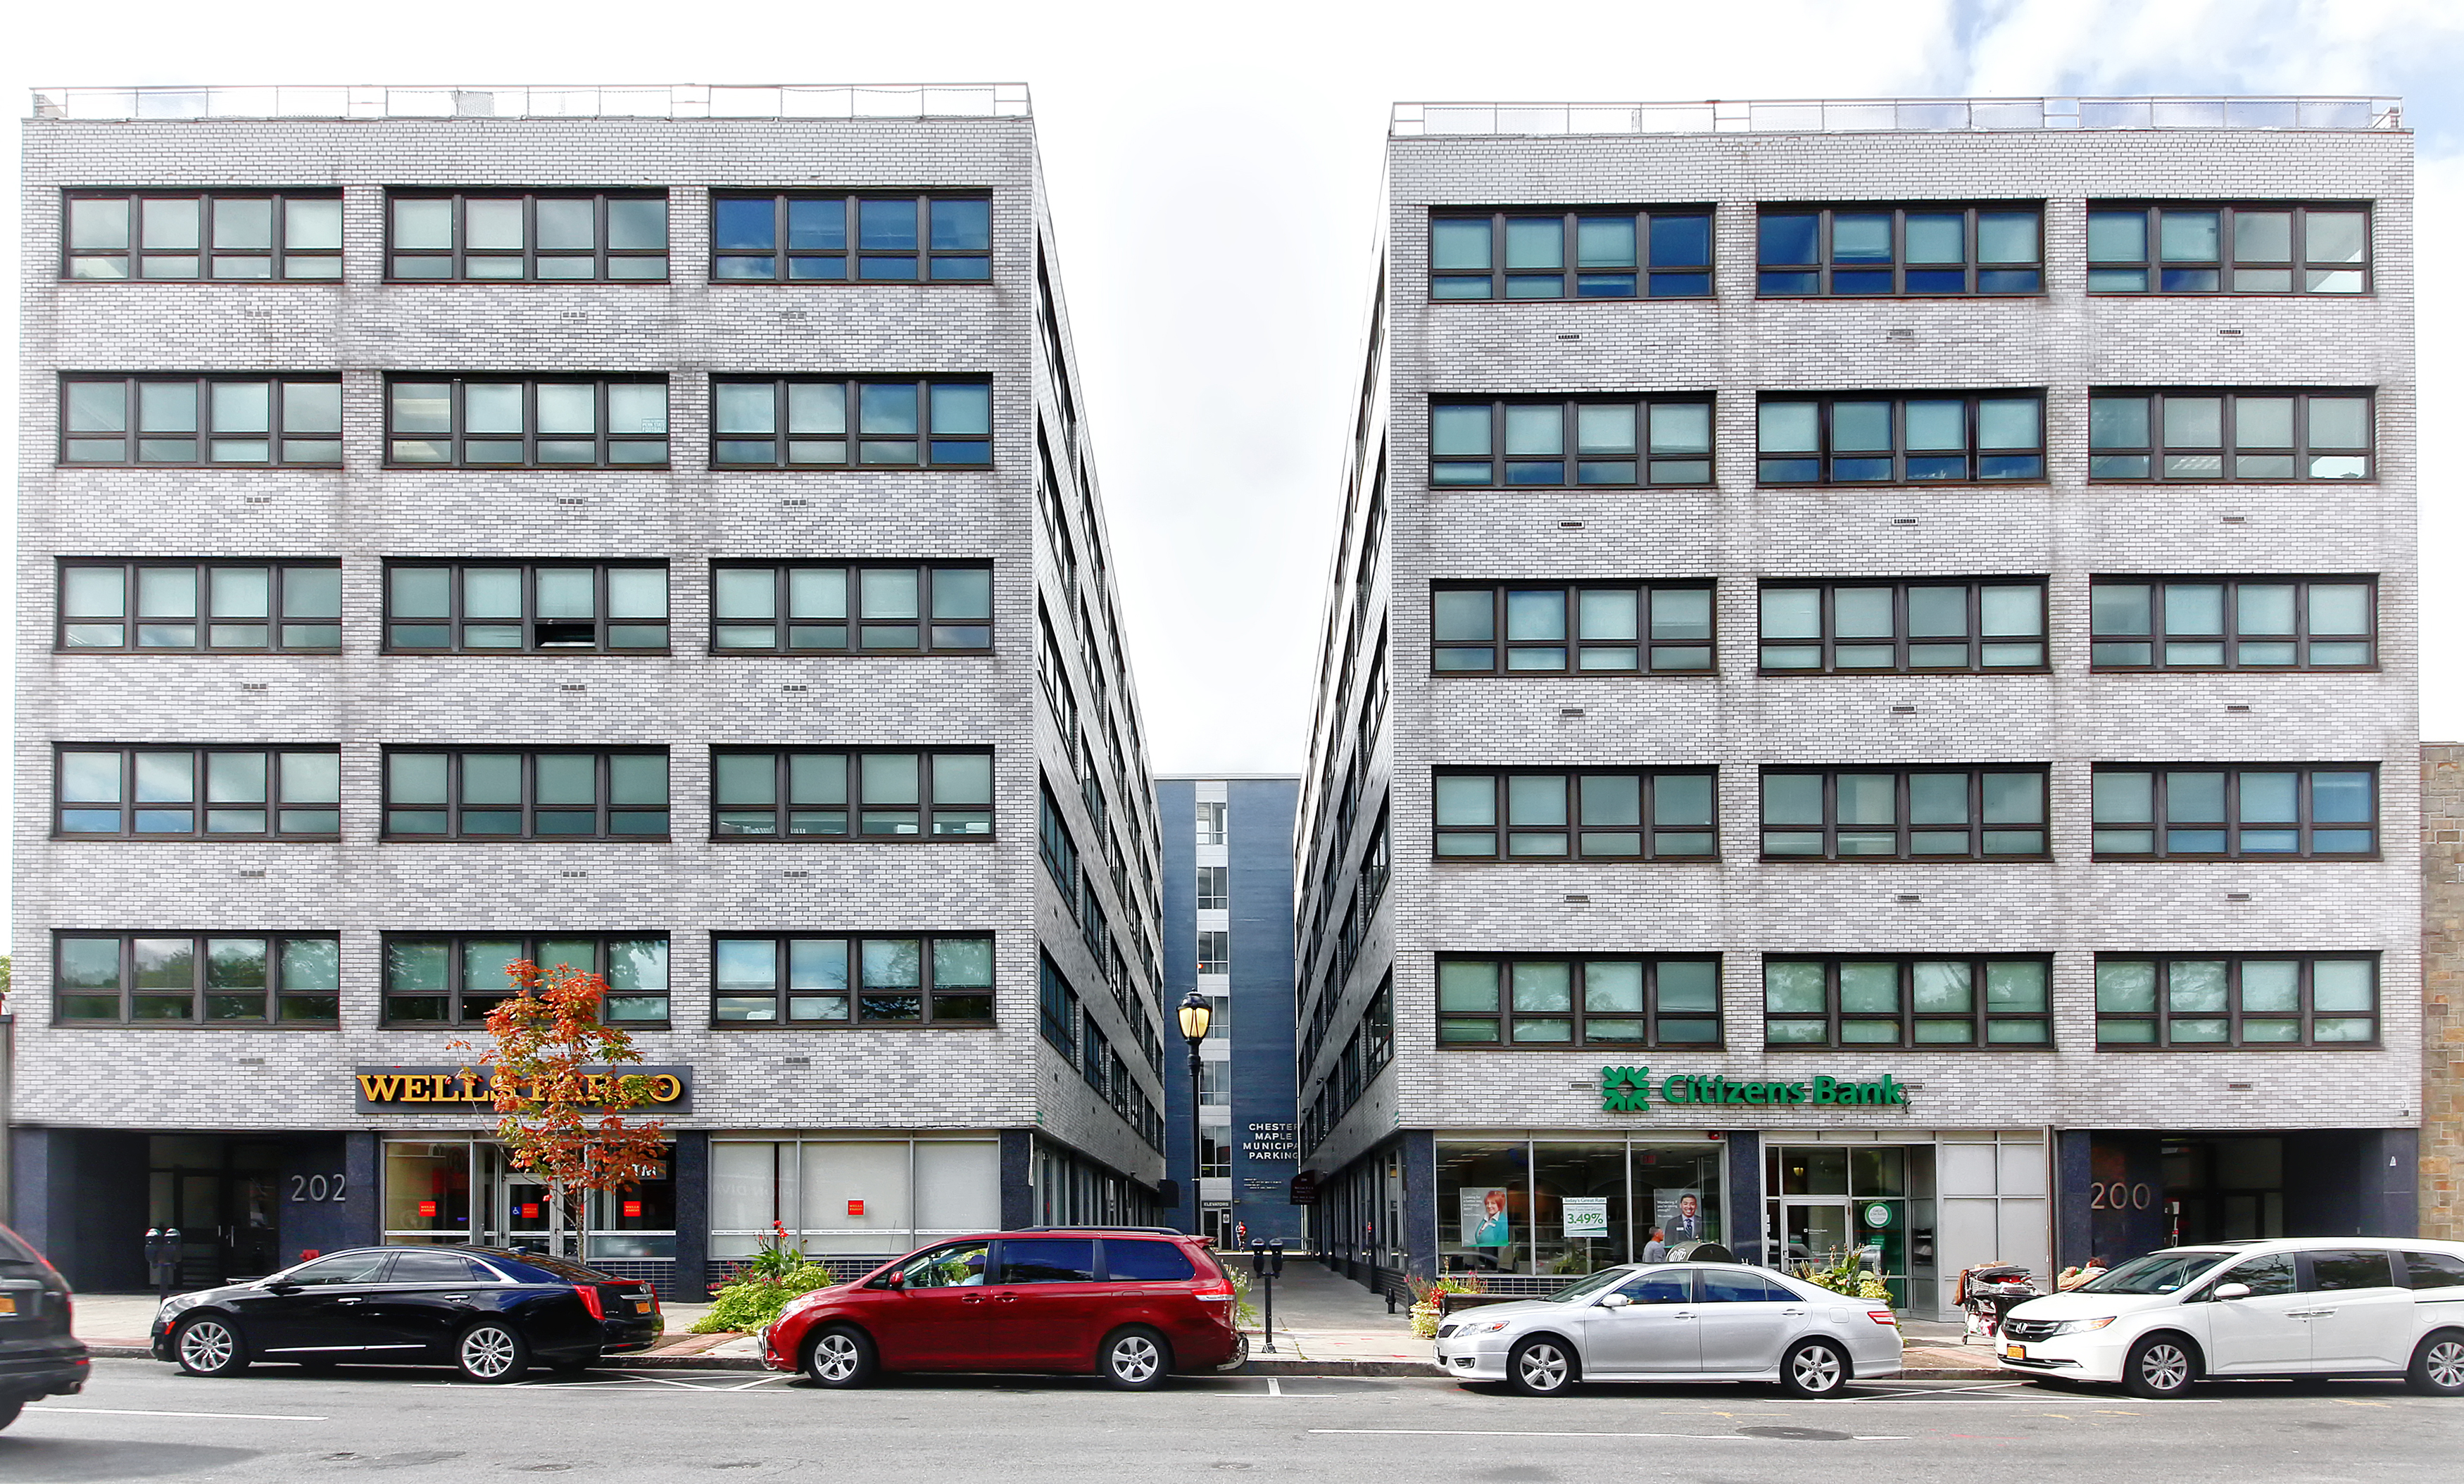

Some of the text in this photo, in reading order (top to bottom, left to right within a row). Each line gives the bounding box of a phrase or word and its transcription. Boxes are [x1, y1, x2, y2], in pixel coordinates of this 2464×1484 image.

[356, 1075, 515, 1102] WELLS
[1662, 1074, 1904, 1105] Citizens Bank
[620, 1164, 658, 1176] TM
[291, 1174, 346, 1201] 202
[2091, 1182, 2150, 1209] 200
[1567, 1213, 1603, 1224] 3.49%
